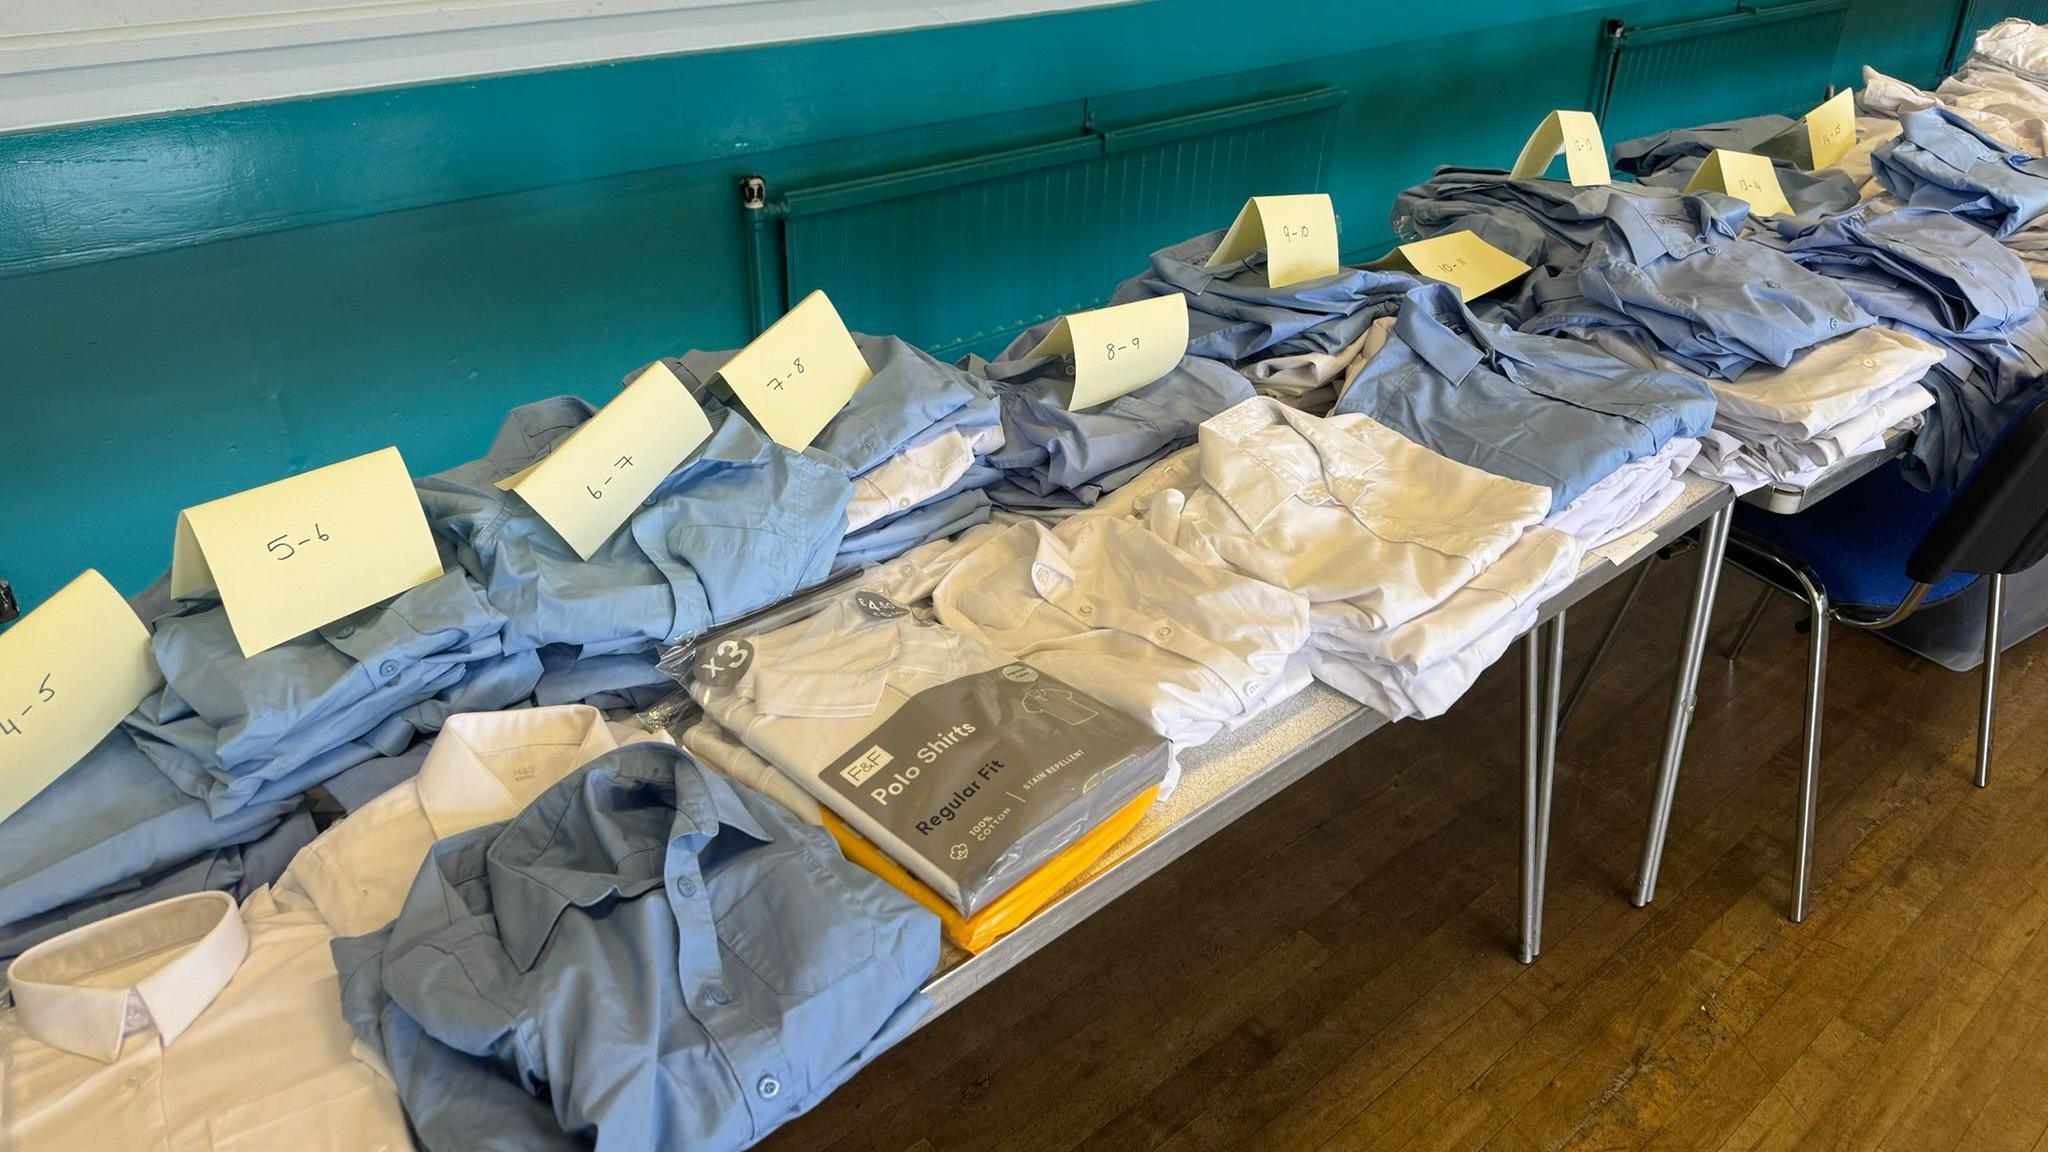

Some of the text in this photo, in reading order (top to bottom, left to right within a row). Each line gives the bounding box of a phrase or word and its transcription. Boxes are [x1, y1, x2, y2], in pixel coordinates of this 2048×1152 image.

[1283, 225, 1310, 243] 9-10
[1106, 337, 1140, 361] 8-9
[766, 357, 805, 391] 7-8
[586, 455, 634, 500] 6-7
[266, 522, 330, 561] 5-6
[0, 672, 56, 735] 4-5
[847, 750, 881, 781] F&F
[870, 722, 977, 806] Polo Shirts
[1022, 749, 1085, 791] STAIN REPELLENT
[915, 759, 1005, 836] Regular Fit
[968, 815, 993, 836] 100%
[977, 807, 1011, 842] COTTON
